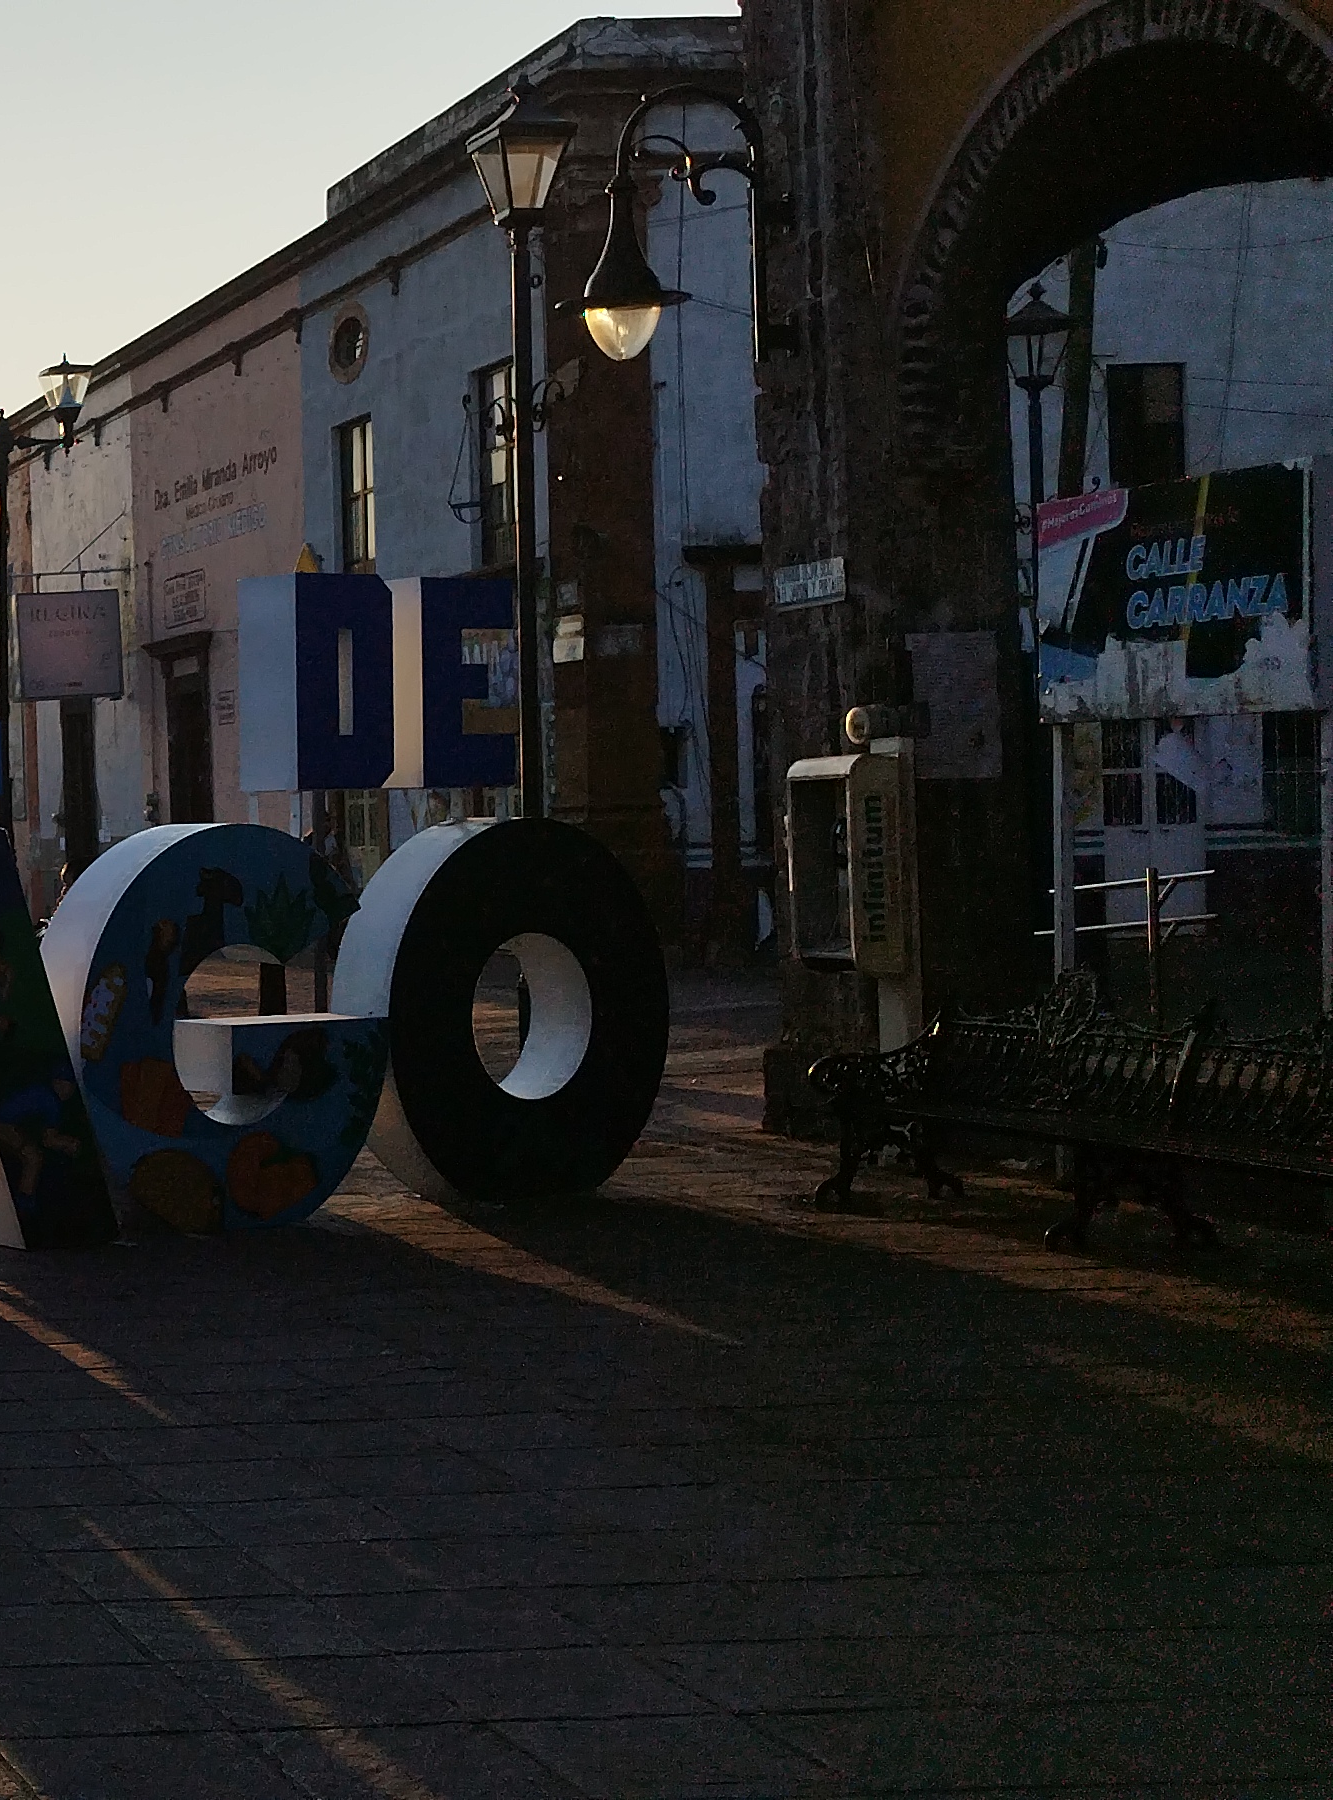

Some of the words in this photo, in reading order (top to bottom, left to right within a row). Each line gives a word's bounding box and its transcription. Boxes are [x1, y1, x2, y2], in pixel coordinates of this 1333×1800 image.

[201, 459, 237, 492] Miranda
[242, 446, 277, 477] Arroyo
[1126, 534, 1207, 581] CALLE
[1126, 572, 1290, 629] CARRANZA
[236, 572, 517, 792] DE
[862, 795, 887, 943] infinitum
